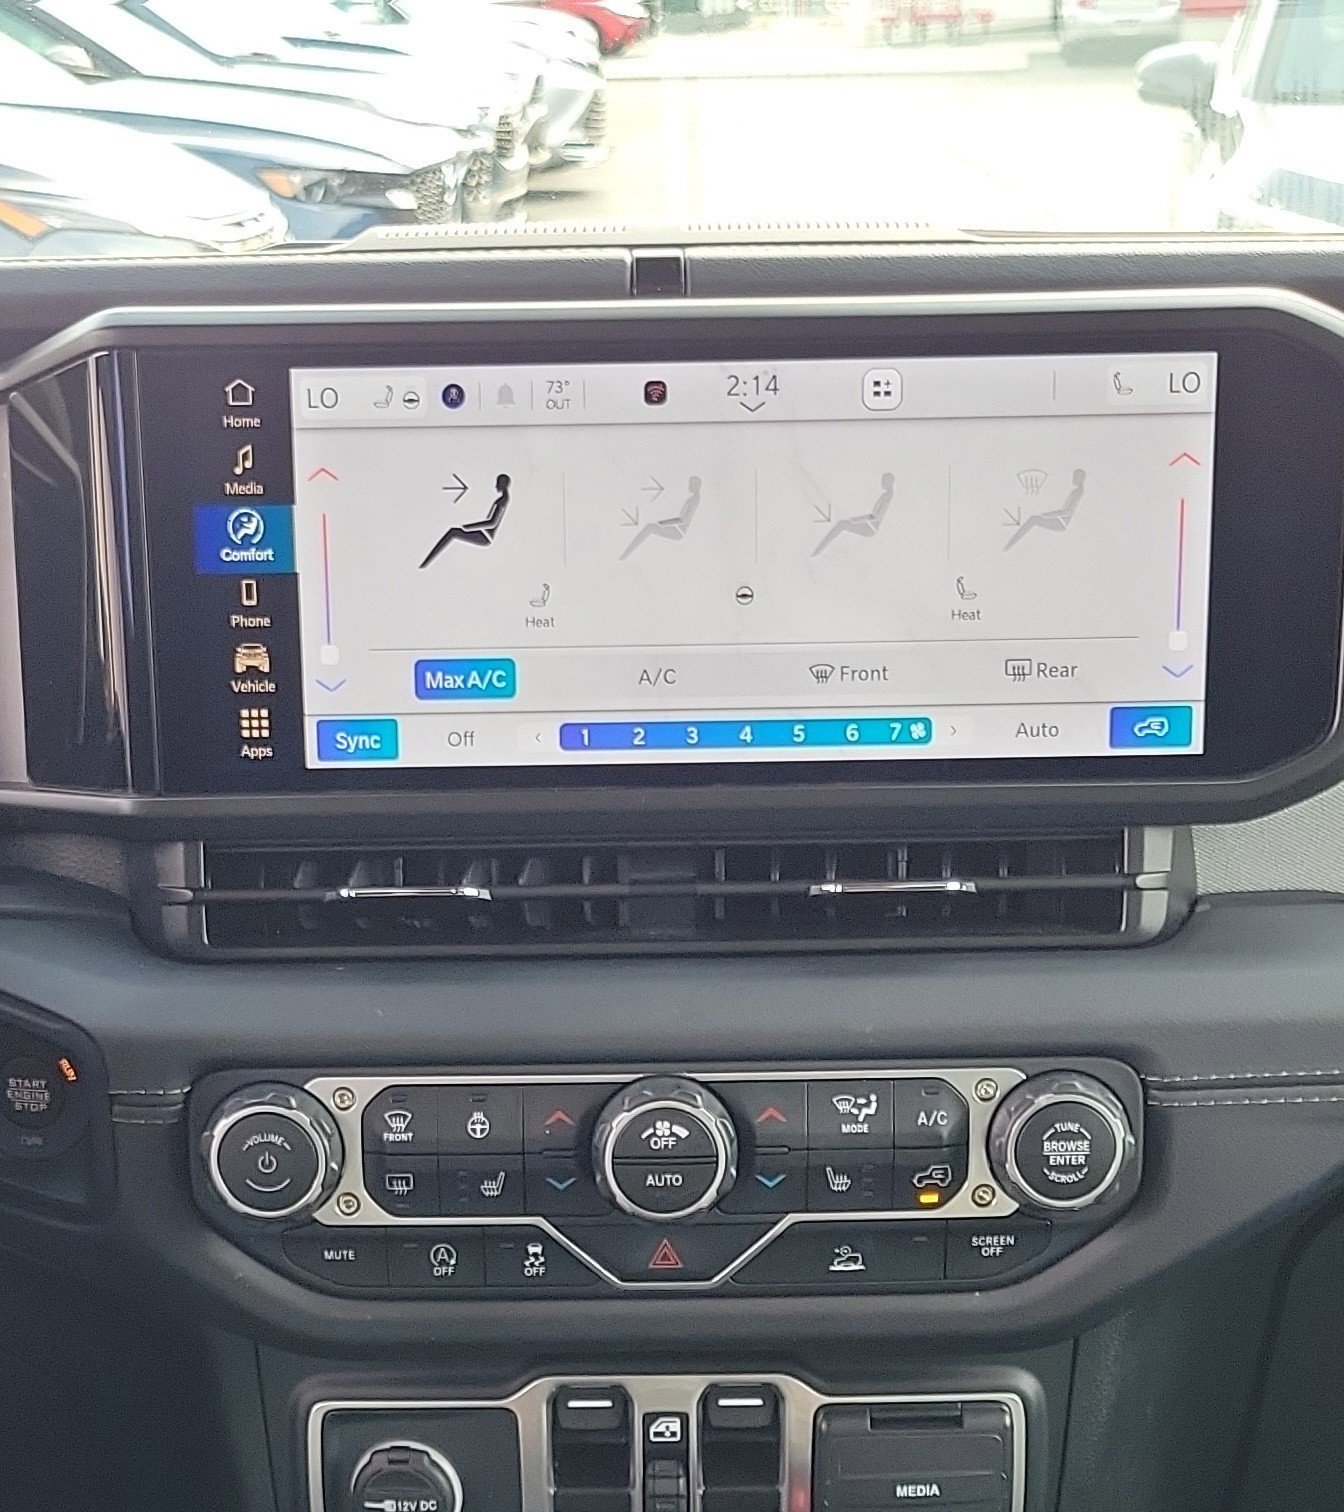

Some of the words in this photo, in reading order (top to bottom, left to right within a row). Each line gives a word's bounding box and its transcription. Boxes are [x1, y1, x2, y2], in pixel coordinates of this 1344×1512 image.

[726, 374, 780, 398] 2:14
[1169, 372, 1201, 394] LO
[307, 388, 339, 410] LO
[546, 398, 571, 410] OUT
[223, 416, 261, 429] Home
[225, 482, 264, 495] Media
[220, 547, 274, 562] Comfort
[231, 614, 271, 628] Phone
[951, 608, 981, 622] Heat
[526, 616, 555, 629] Heat
[840, 665, 889, 682] Front
[1037, 662, 1078, 679] Rear
[425, 671, 467, 689] Max
[468, 669, 508, 690] A/C
[639, 669, 677, 687] A/C
[231, 680, 276, 693] Vehicle
[579, 730, 590, 746] 1
[632, 729, 646, 746] 2
[686, 728, 700, 744] 3
[739, 725, 753, 743] 4
[793, 725, 806, 742] 5
[846, 724, 860, 742] 6
[889, 723, 902, 740] 7
[1016, 722, 1059, 739] Auto
[336, 732, 381, 753] Sync
[447, 730, 475, 748] Off
[241, 745, 273, 760] Apps
[8, 1077, 48, 1089] START
[7, 1089, 51, 1101] ENGINE
[14, 1102, 48, 1112] STOP
[917, 1111, 948, 1127] A/C
[841, 1123, 869, 1134] MODE
[1054, 1121, 1081, 1133] TUNE
[247, 1131, 285, 1147] VOLUME
[383, 1132, 413, 1143] FRONT
[650, 1136, 677, 1150] OFF
[1043, 1140, 1090, 1152] BROWSE
[1049, 1155, 1086, 1166] ENTER
[645, 1174, 683, 1188] AUTO
[1048, 1171, 1085, 1184] SCROLL
[971, 1235, 1014, 1247] SCREEN
[324, 1249, 355, 1261] MUTE
[981, 1246, 1003, 1257] OFF
[432, 1266, 455, 1277] OFF
[524, 1266, 545, 1277] OFF
[896, 1483, 940, 1498] MEDIA
[398, 1499, 417, 1512] 12V
[419, 1499, 438, 1511] DC
